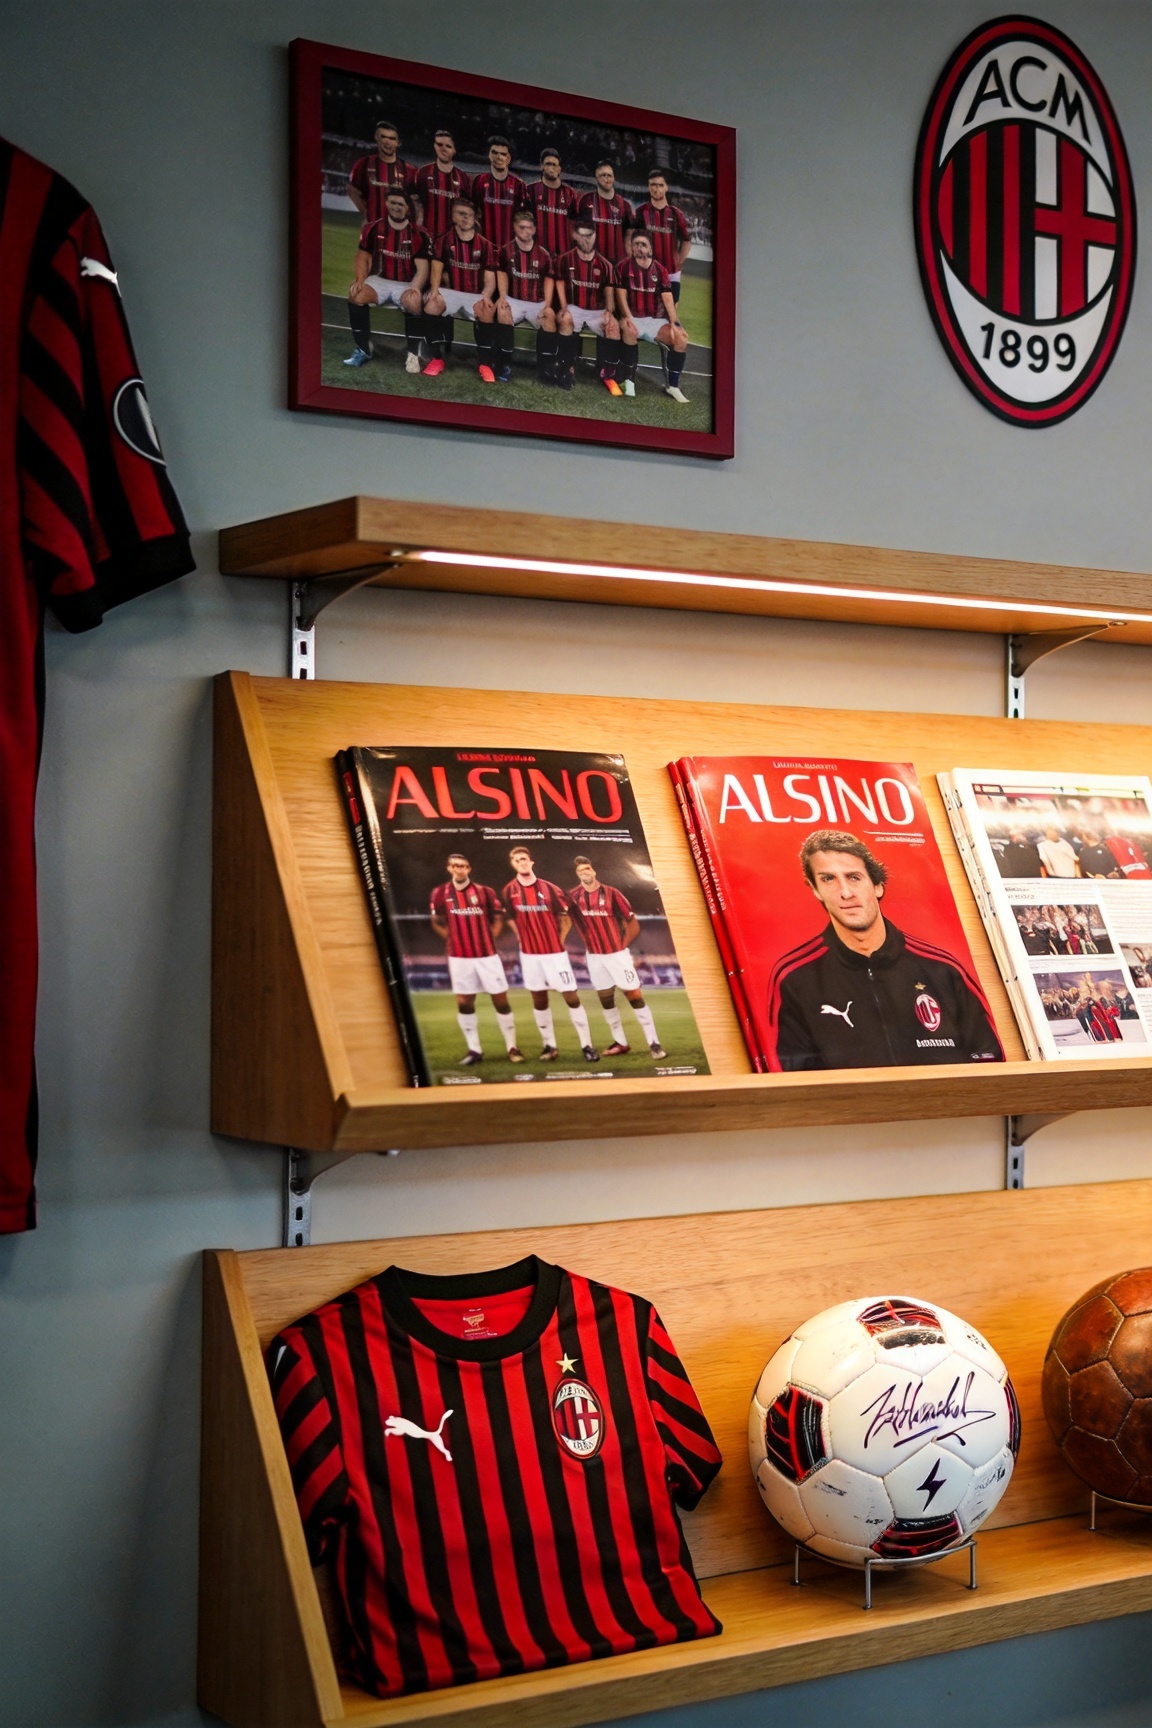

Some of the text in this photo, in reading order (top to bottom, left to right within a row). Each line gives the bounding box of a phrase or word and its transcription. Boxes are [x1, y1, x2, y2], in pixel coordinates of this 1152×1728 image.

[962, 55, 1092, 147] ACM
[979, 321, 1077, 373] 1899
[386, 765, 624, 824] ALSINO
[718, 772, 915, 826] ALSINO
